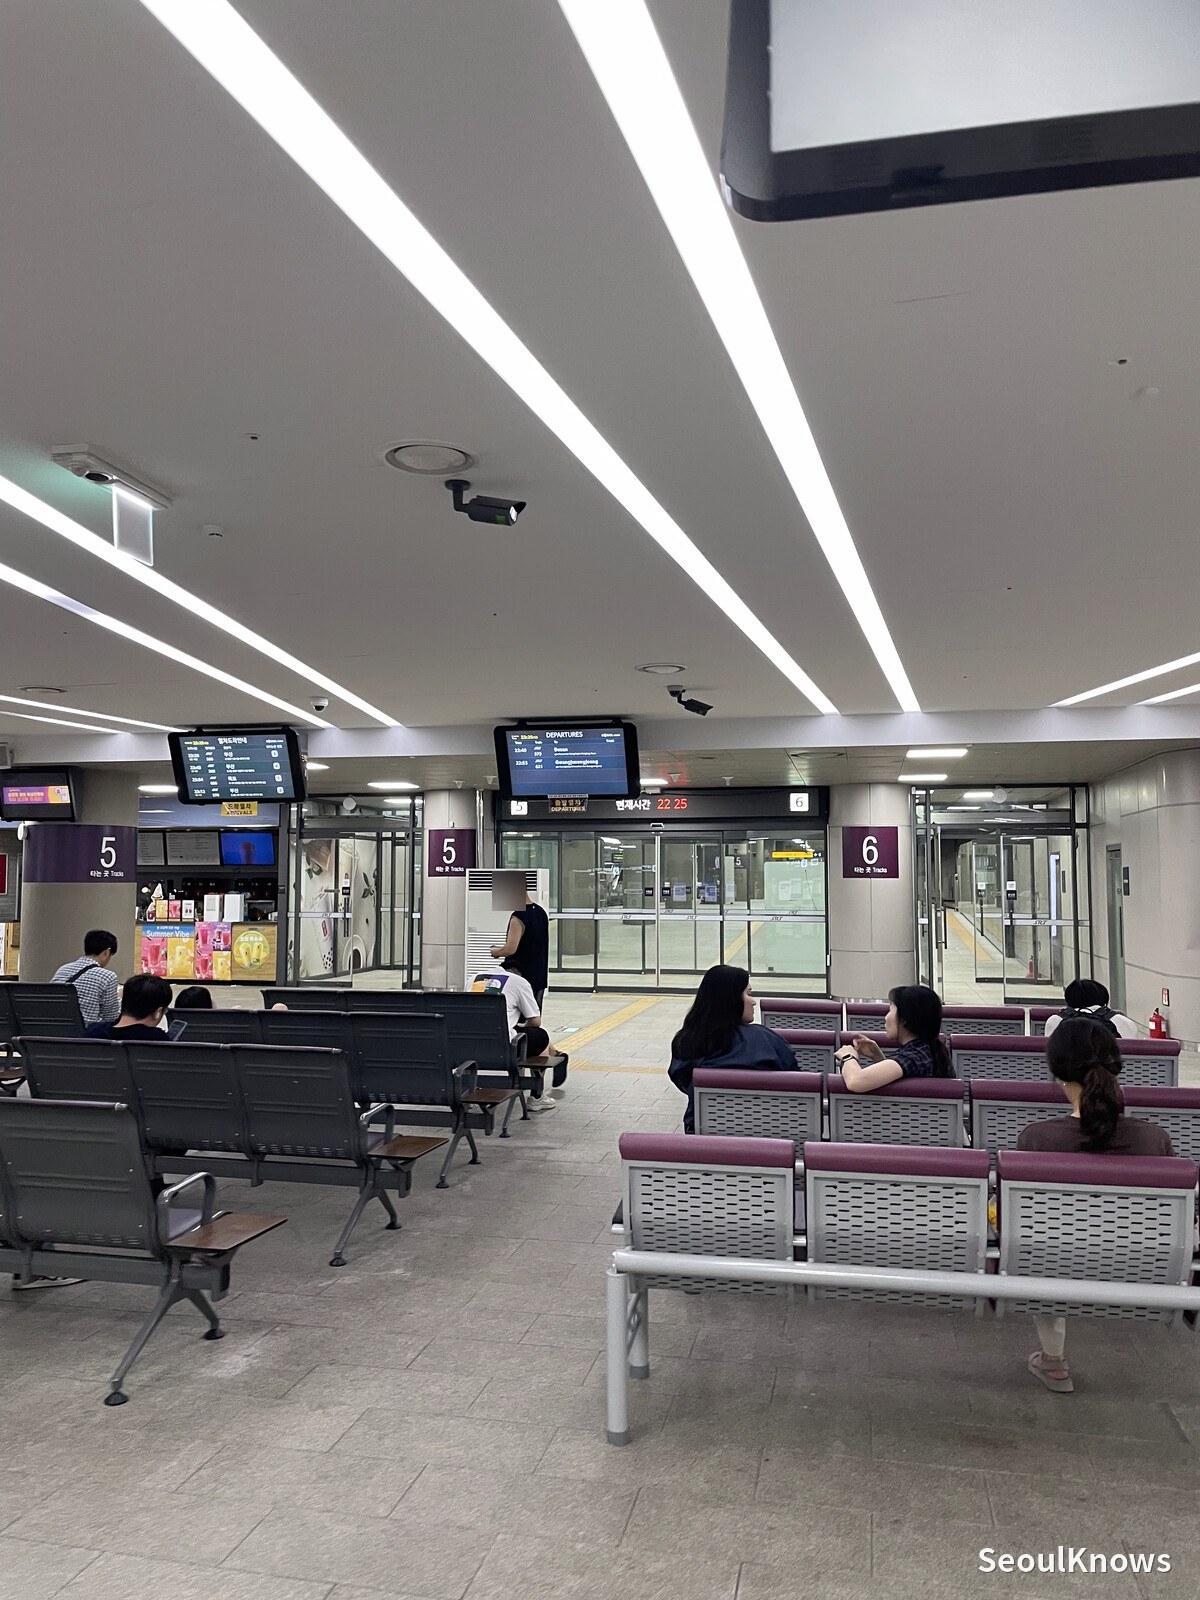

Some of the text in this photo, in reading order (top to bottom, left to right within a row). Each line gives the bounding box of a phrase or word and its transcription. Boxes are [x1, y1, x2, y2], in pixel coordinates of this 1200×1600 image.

[616, 798, 688, 811] 현재시간 22 25
[796, 797, 803, 807] 6
[100, 837, 116, 868] 5
[442, 838, 456, 864] 5
[862, 836, 878, 864] 6
